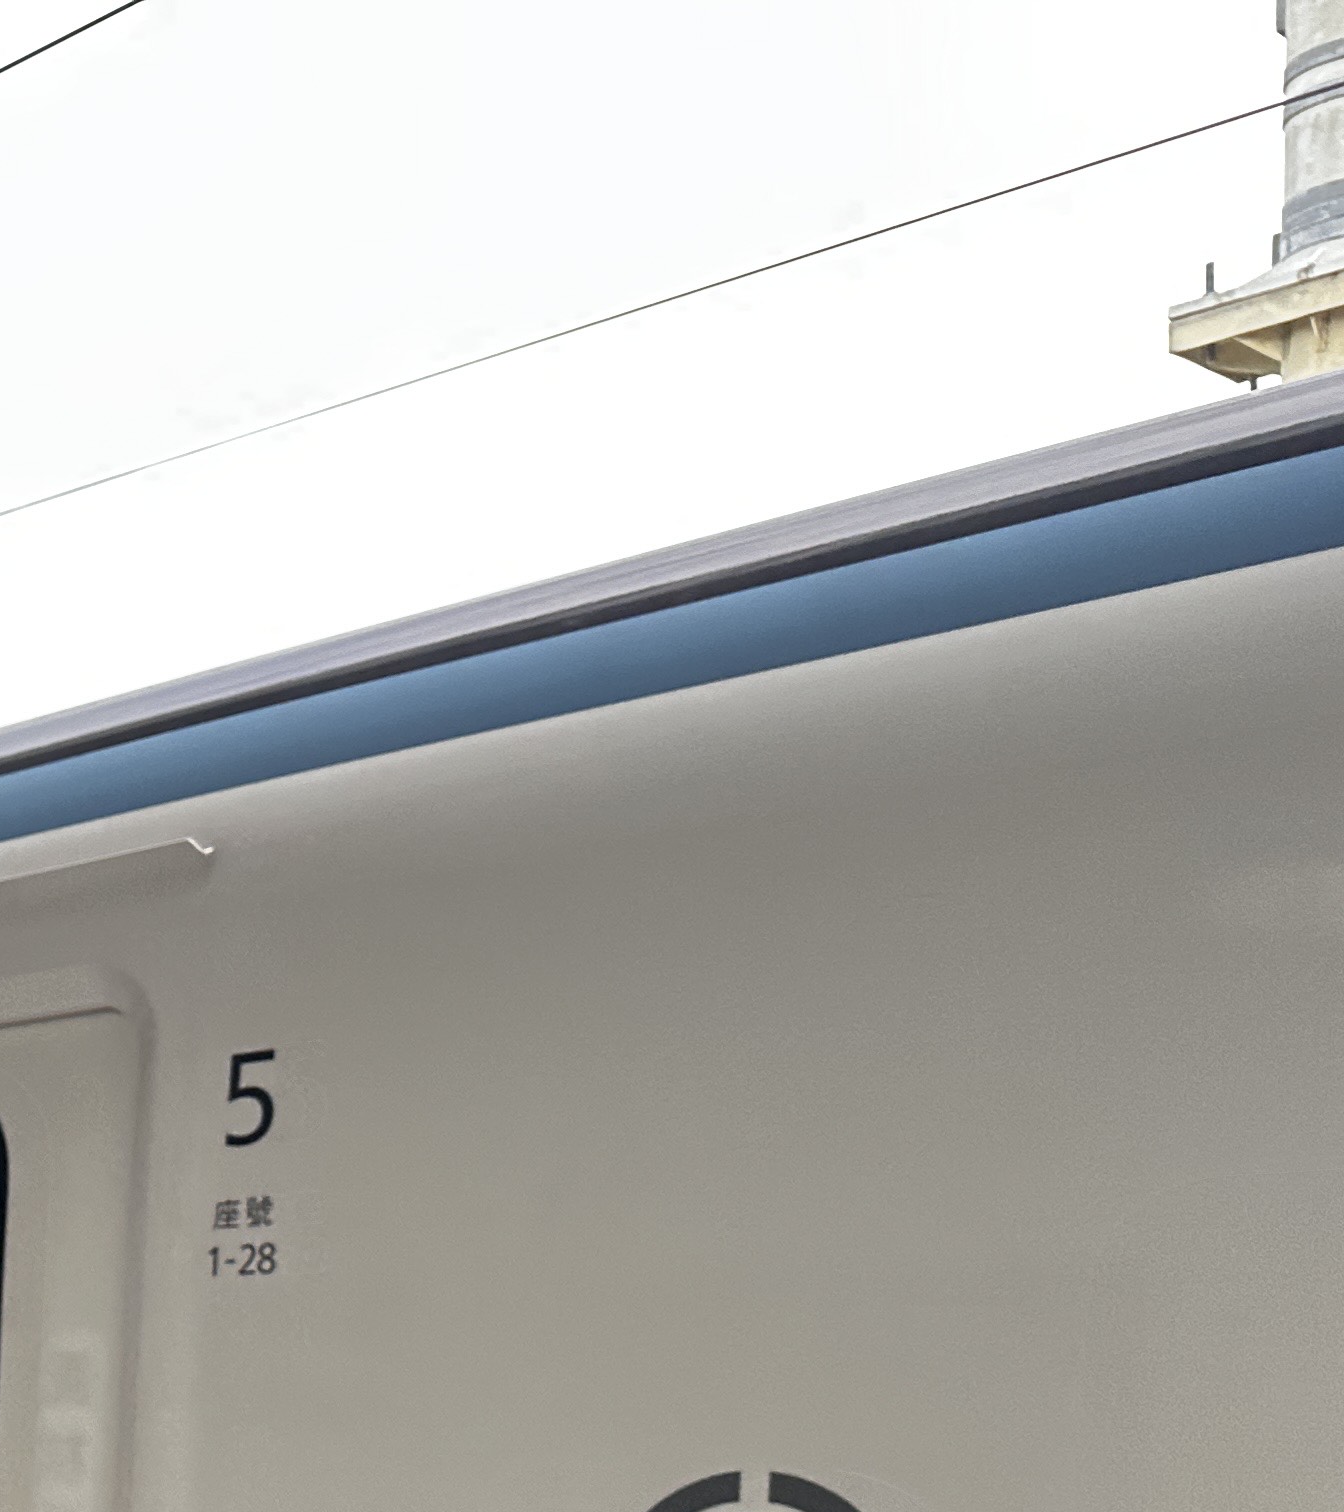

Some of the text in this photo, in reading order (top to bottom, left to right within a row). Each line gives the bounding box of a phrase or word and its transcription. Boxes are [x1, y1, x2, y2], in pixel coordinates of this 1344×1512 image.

[224, 1049, 275, 1147] 5
[213, 1196, 273, 1229] 座號
[209, 1242, 278, 1276] 1-28
